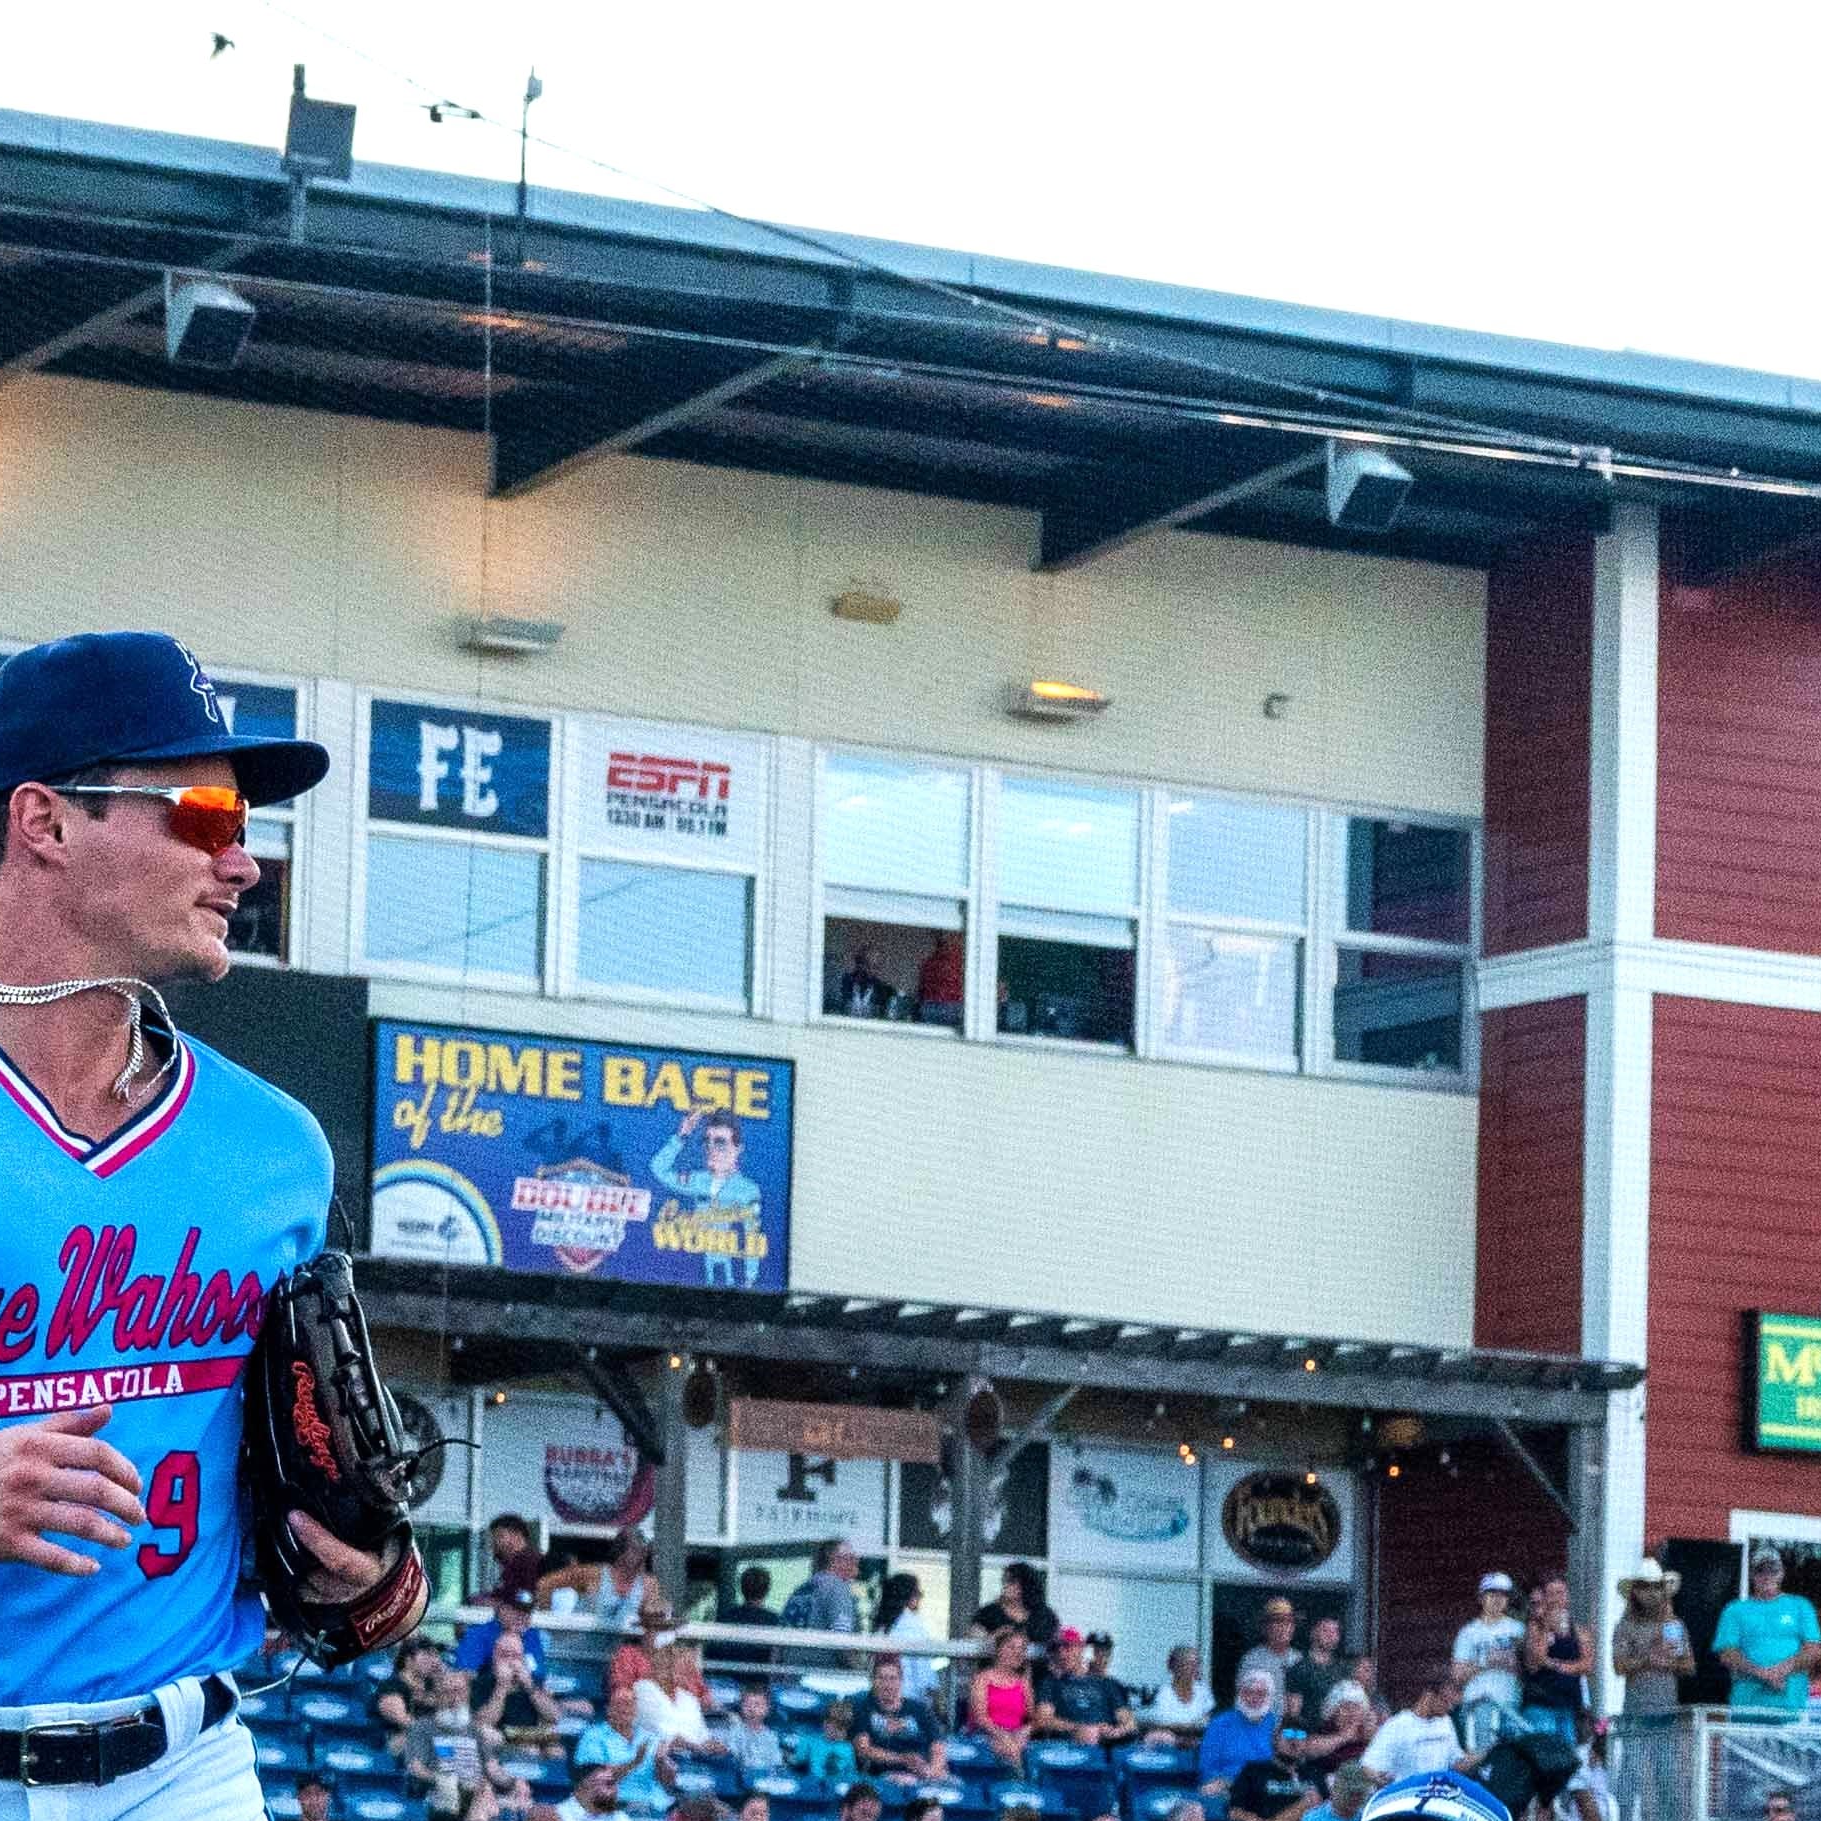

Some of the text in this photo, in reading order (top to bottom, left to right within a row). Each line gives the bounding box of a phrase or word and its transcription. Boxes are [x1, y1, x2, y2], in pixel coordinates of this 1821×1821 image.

[418, 721, 502, 817] FE
[607, 752, 732, 799] ESPN
[393, 1033, 771, 1120] HOME BASE
[393, 1082, 504, 1150] of the
[45, 1220, 271, 1366] Wahoo
[137, 1449, 202, 1581] 9
